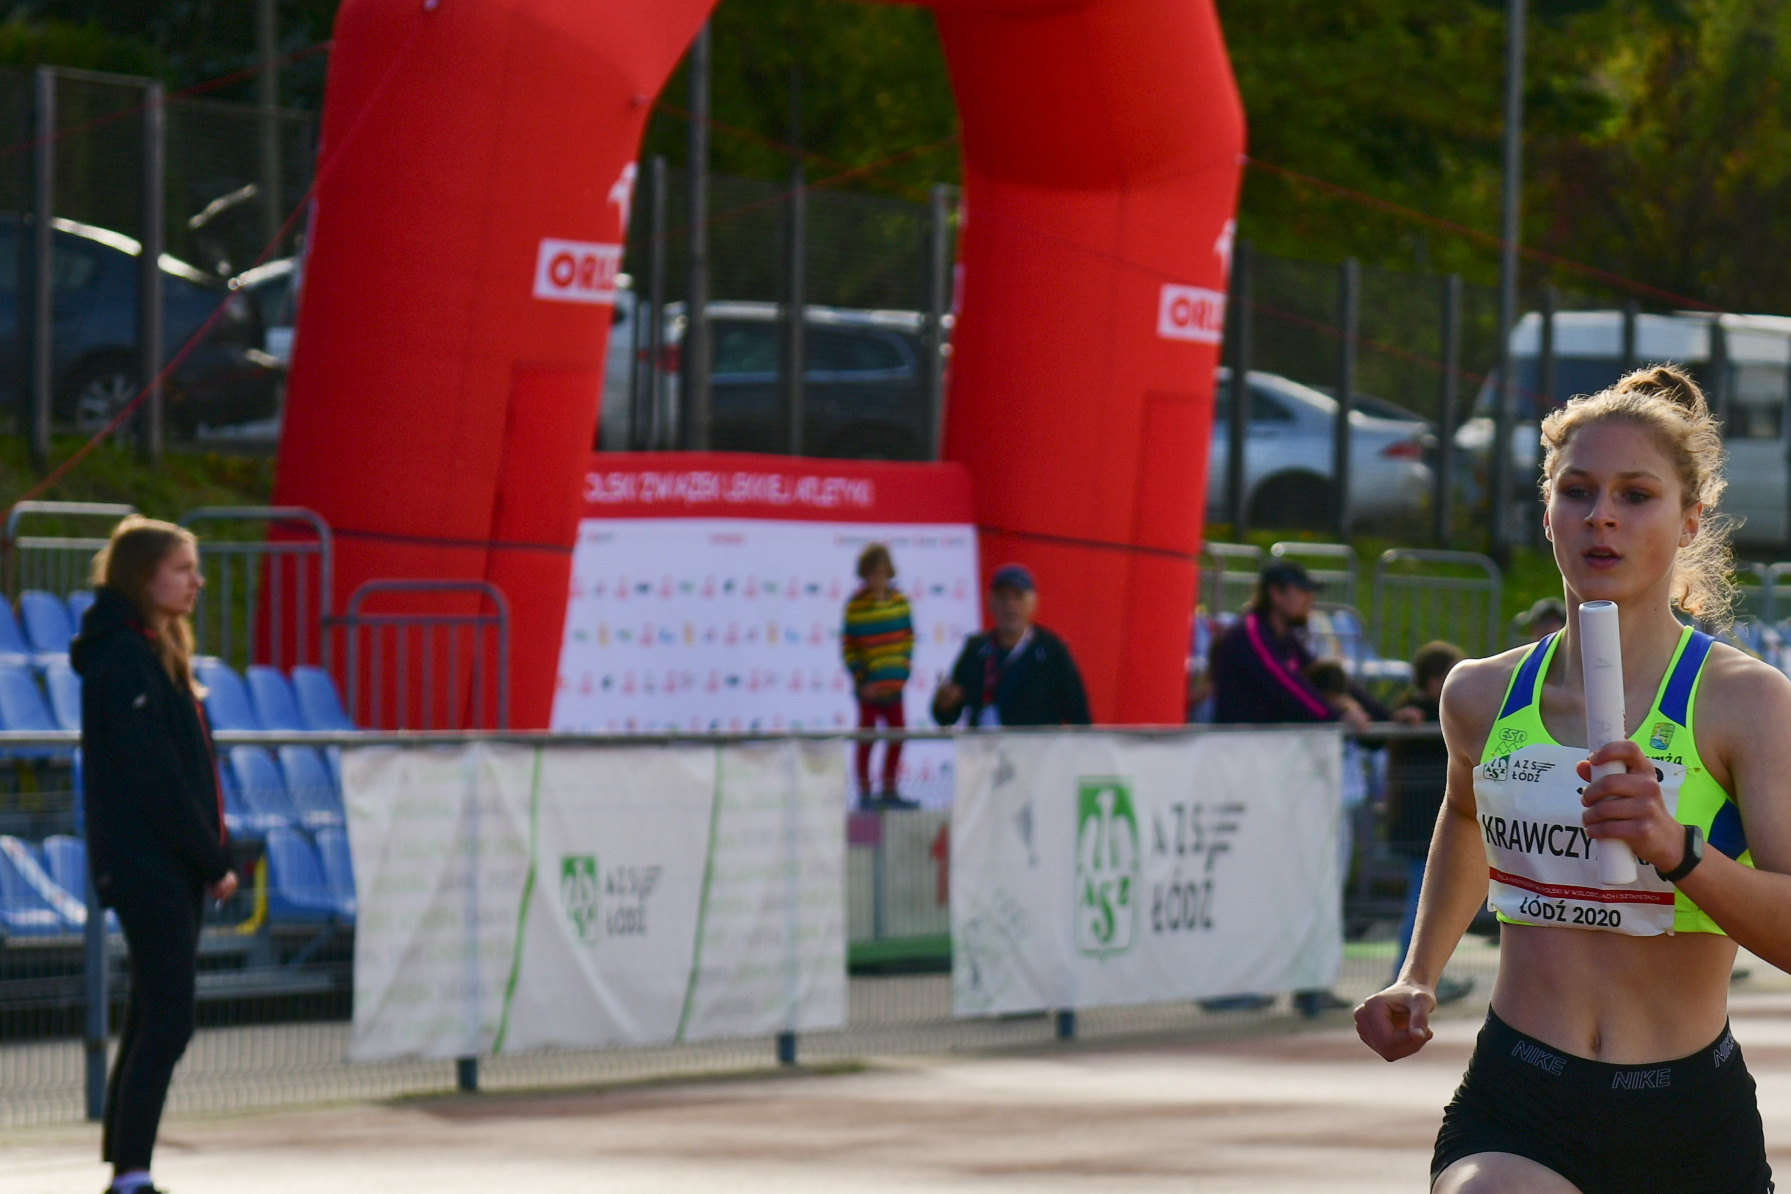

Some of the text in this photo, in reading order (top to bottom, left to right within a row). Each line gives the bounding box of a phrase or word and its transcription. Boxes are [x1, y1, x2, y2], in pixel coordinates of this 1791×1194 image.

[548, 252, 624, 290] ORL
[1170, 297, 1224, 331] ORL
[1645, 753, 1683, 766] mża
[1482, 814, 1650, 865] KRAWCZY
[1520, 895, 1621, 928] ŁÓDŹ 2020
[1511, 1040, 1566, 1076] NIKE
[1612, 1067, 1671, 1090] NIKE
